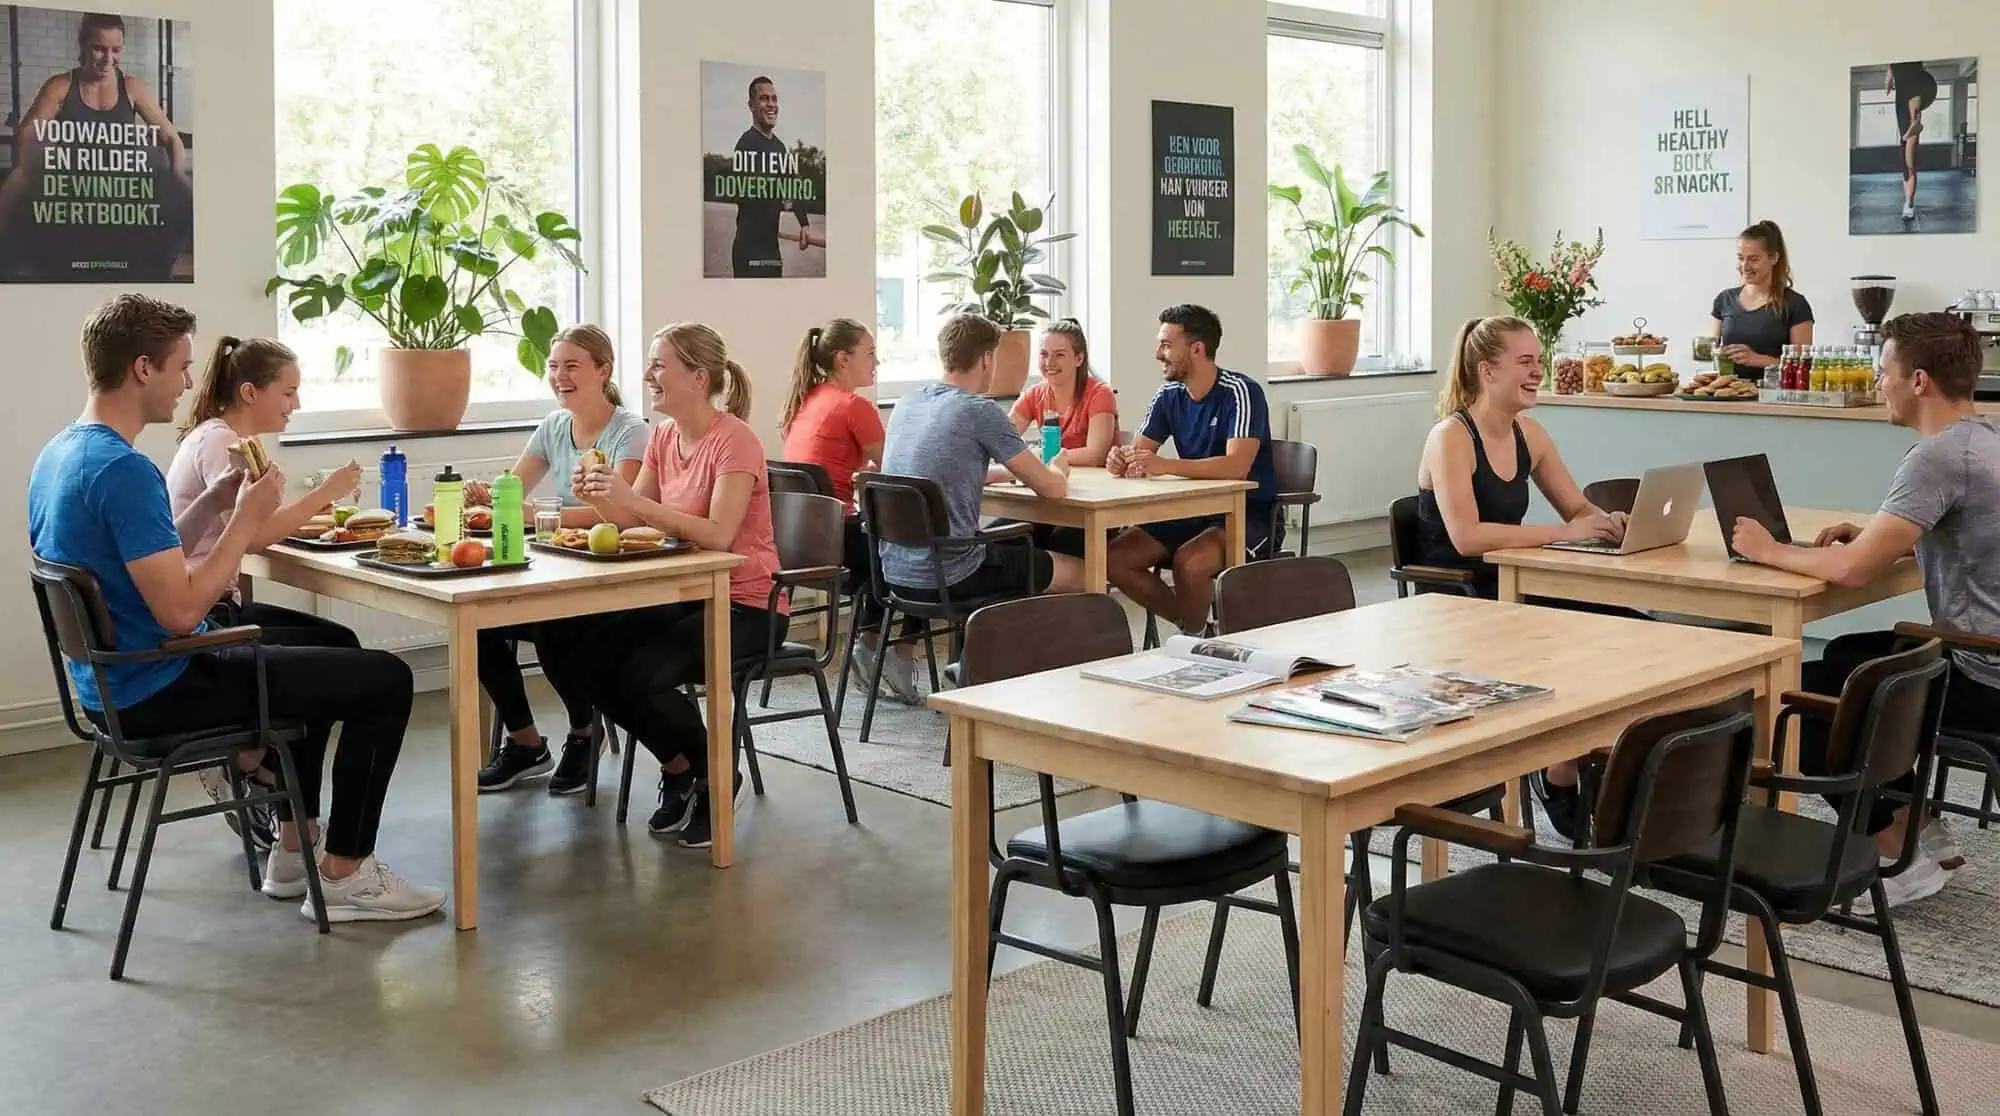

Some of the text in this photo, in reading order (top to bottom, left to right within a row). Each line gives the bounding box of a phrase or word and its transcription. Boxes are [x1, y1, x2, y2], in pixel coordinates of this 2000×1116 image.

[1674, 108, 1713, 129] HELL
[33, 119, 161, 147] VOOWADERT
[1658, 128, 1729, 152] HEALTHY
[44, 147, 153, 173] EN RILDER.
[733, 150, 758, 173] DIT
[43, 174, 69, 197] DE
[1183, 199, 1205, 217] VON
